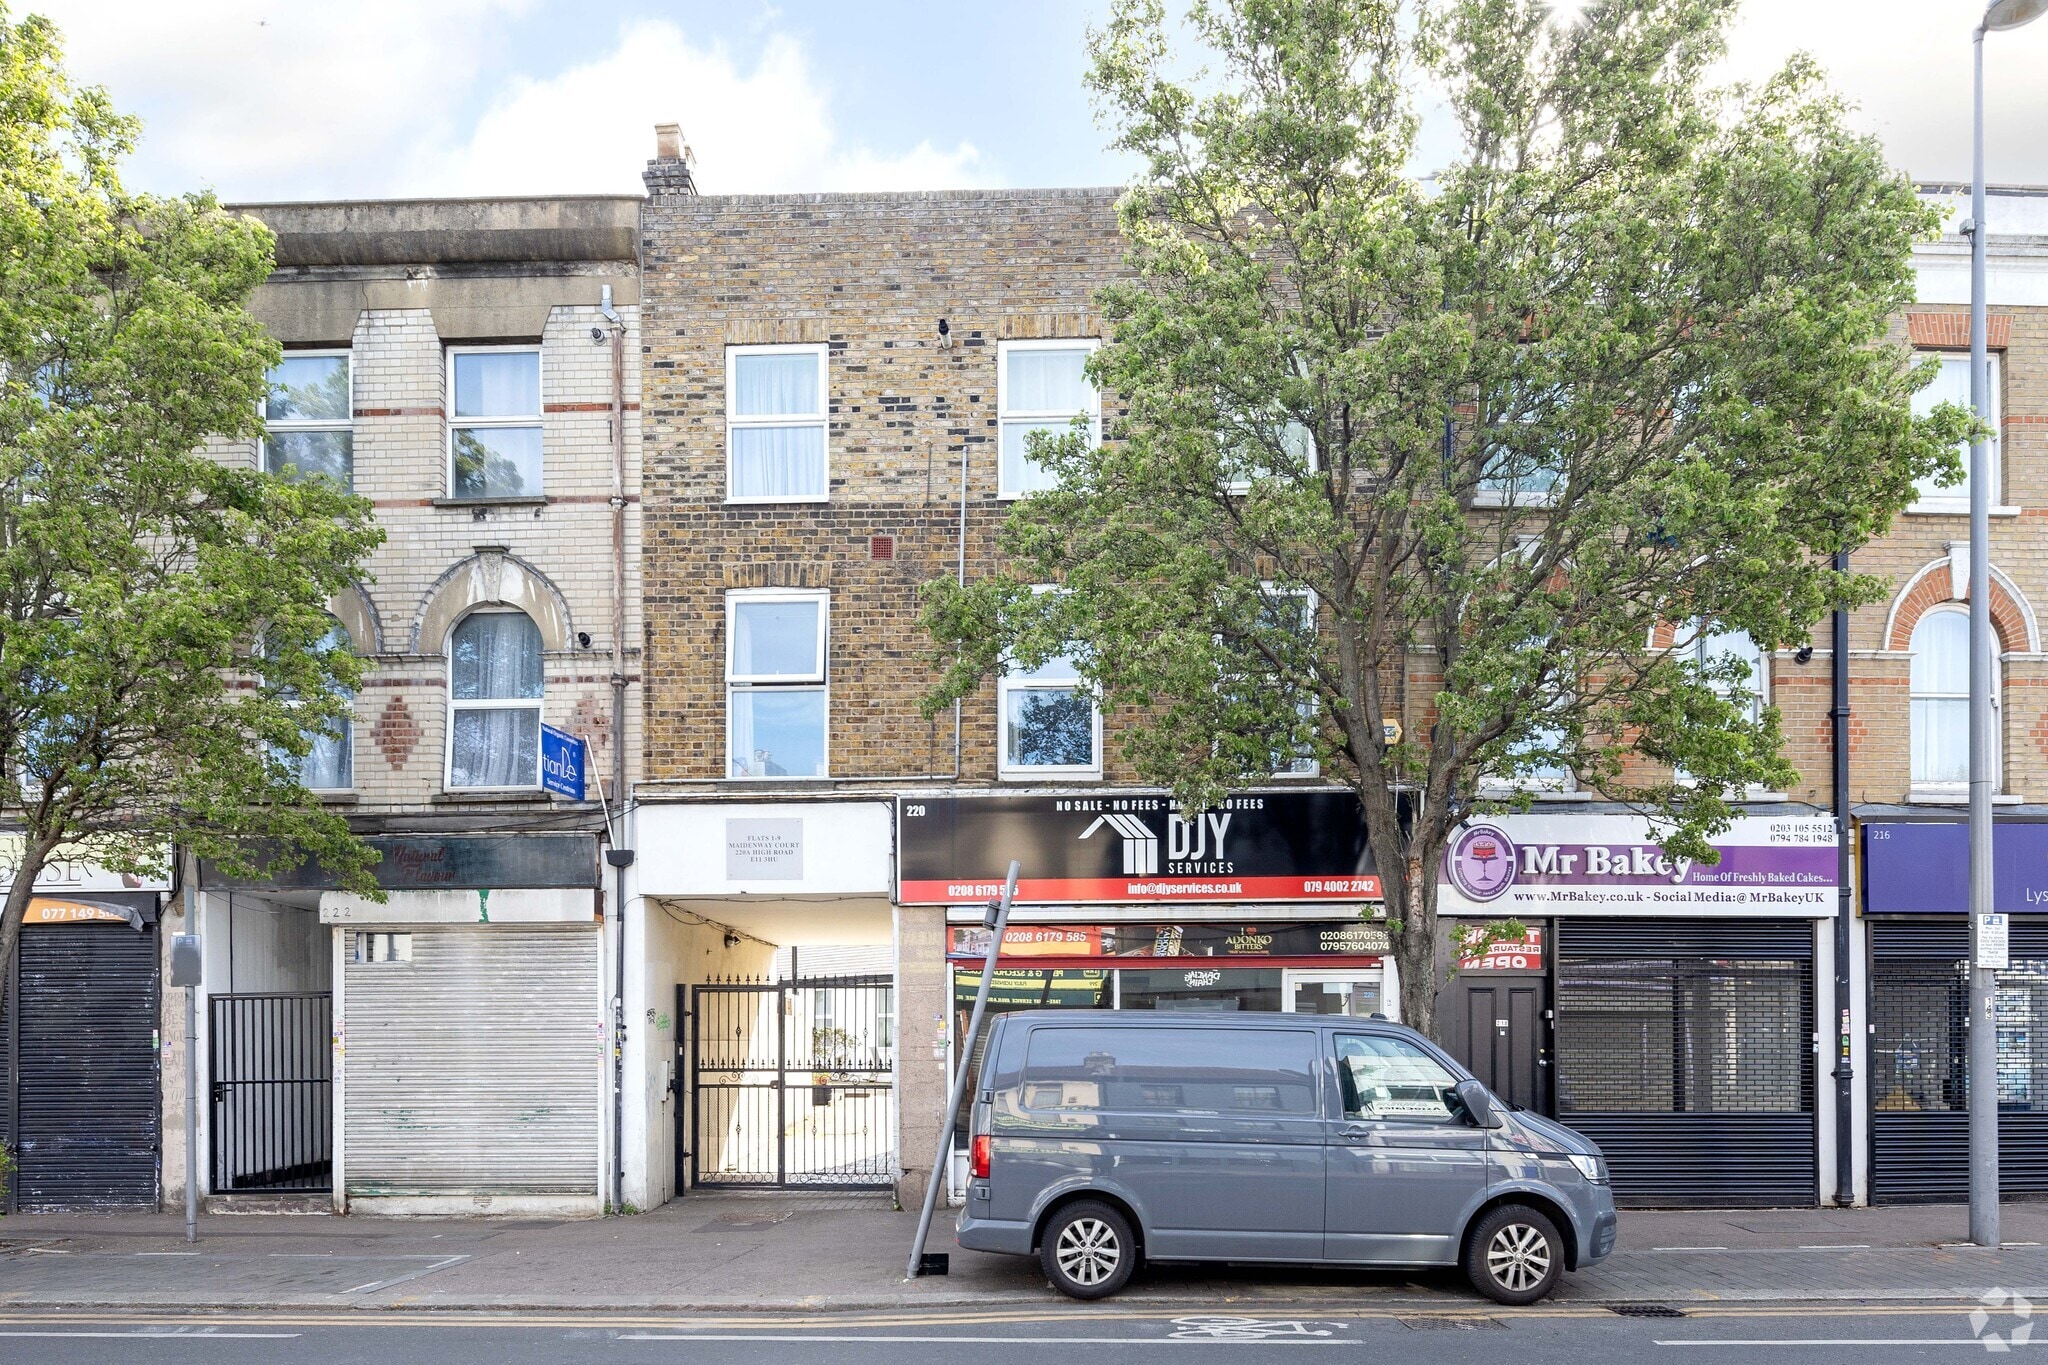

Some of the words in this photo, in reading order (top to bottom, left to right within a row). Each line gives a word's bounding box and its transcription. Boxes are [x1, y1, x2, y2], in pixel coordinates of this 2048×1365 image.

[906, 805, 926, 817] 220
[1056, 800, 1071, 812] NO
[1074, 800, 1103, 811] SALE
[1113, 800, 1128, 811] NO
[1131, 799, 1159, 811] FEES
[1236, 798, 1264, 810] FEES
[1770, 824, 1791, 833] 0203
[1794, 824, 1809, 833] 105
[1812, 824, 1833, 833] 5512
[1168, 813, 1232, 860] DJY
[1770, 834, 1791, 843] 0794
[1794, 834, 1809, 843] 784
[1812, 834, 1833, 843] 1948
[1873, 830, 1891, 840] 216
[1168, 862, 1234, 874] SERVICES
[1522, 846, 1578, 875] Mr
[1584, 846, 1693, 885] Bakey
[1693, 872, 1719, 882] Home
[1720, 872, 1733, 882] Of
[1733, 872, 1766, 885] Freshly
[1768, 872, 1796, 883] Baked
[1797, 872, 1833, 883] Cakes...
[948, 884, 974, 896] 0208
[975, 884, 998, 896] 6179
[999, 884, 1019, 896] 55
[1127, 882, 1242, 896] info@djyservices.co.uk
[1304, 880, 1323, 893] 079
[1323, 880, 1349, 893] 4002
[1351, 880, 1375, 893] 2742
[1514, 891, 1644, 904] www.MrBakey.co.uk
[1653, 891, 1691, 902] Social
[1750, 892, 1825, 905] MrBakeyUK
[42, 908, 67, 920] 077
[70, 908, 95, 919] 149
[1984, 915, 1991, 925] P
[1005, 932, 1033, 942] 0208
[1035, 932, 1063, 942] 6179
[1066, 931, 1087, 942] 585
[1225, 935, 1273, 945] ADONKO
[1320, 941, 1390, 951] 07957604074
